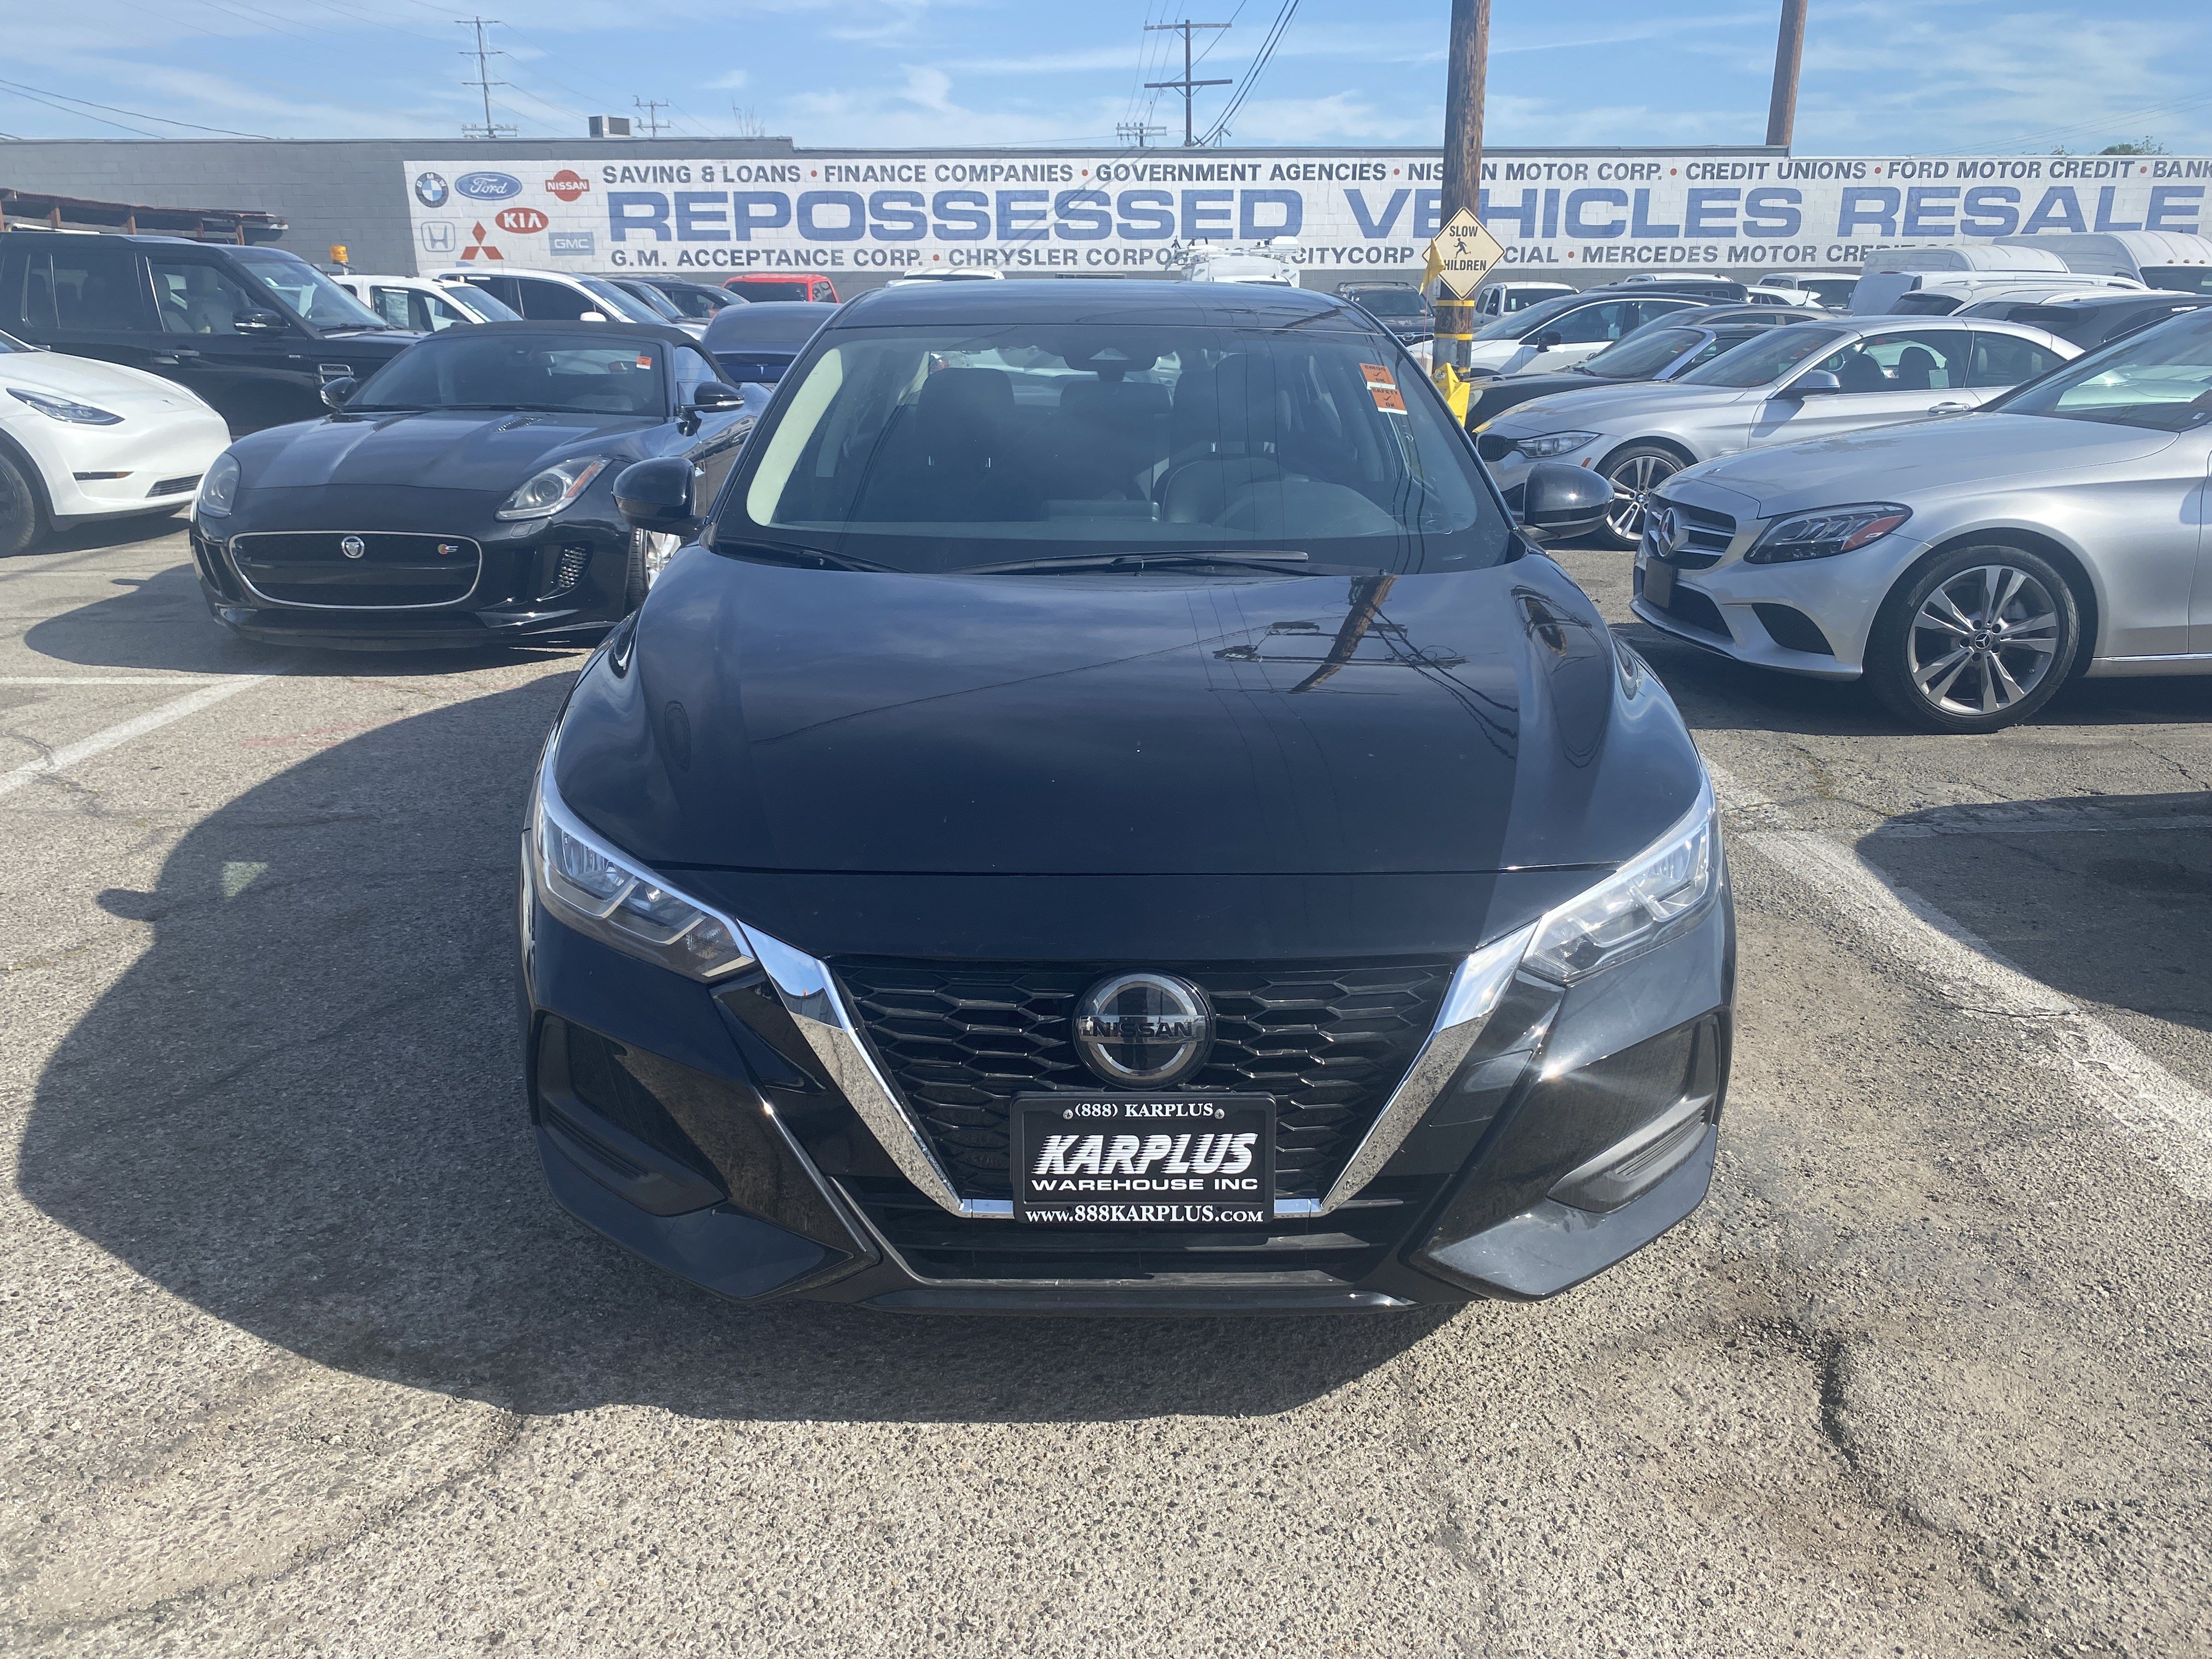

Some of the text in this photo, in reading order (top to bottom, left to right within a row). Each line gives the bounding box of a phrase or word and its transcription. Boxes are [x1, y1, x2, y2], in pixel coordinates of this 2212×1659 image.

[602, 166, 691, 183] SAVING
[702, 166, 714, 183] &
[723, 165, 800, 183] LOANS
[825, 165, 926, 182] FINANCE
[935, 165, 1073, 182] COMPANIES
[1096, 163, 1262, 182] GOVERNMENT
[1269, 163, 1386, 181] AGENCIES
[1408, 163, 1497, 180] NISN
[1505, 163, 1588, 180] MOTOR
[1598, 163, 1662, 180] CORP.
[1686, 162, 1770, 180] CREDIT
[1778, 162, 1866, 180] UNIONS
[1887, 162, 1949, 179] FORD
[1956, 161, 2042, 178] MOTOR
[2049, 161, 2135, 178] CREDIT
[416, 173, 447, 188] BMW
[470, 177, 507, 194] Ford
[548, 180, 588, 190] NISSAN
[503, 212, 543, 229] KIA
[607, 186, 2205, 241] REPOSSESSED VEHICLES RESALE
[1449, 225, 1478, 237] SLOW
[554, 238, 589, 250] GMC
[611, 250, 667, 267] G.M.
[678, 249, 844, 266] ACCEPTANCE
[854, 249, 922, 266] CORP.
[949, 248, 1077, 266] CHRYSLER
[1291, 247, 1414, 264] CITYCORP
[1582, 246, 1718, 263] MERCEDES
[1728, 245, 1818, 263] MOTOR
[1443, 259, 1487, 271] HILDREN
[1093, 1022, 1193, 1038] NISSAN
[1074, 1103, 1214, 1118] (888) KARPLUS
[1031, 1132, 1259, 1175] KARPLUS
[1031, 1178, 1259, 1191] WAREHOUSE INC
